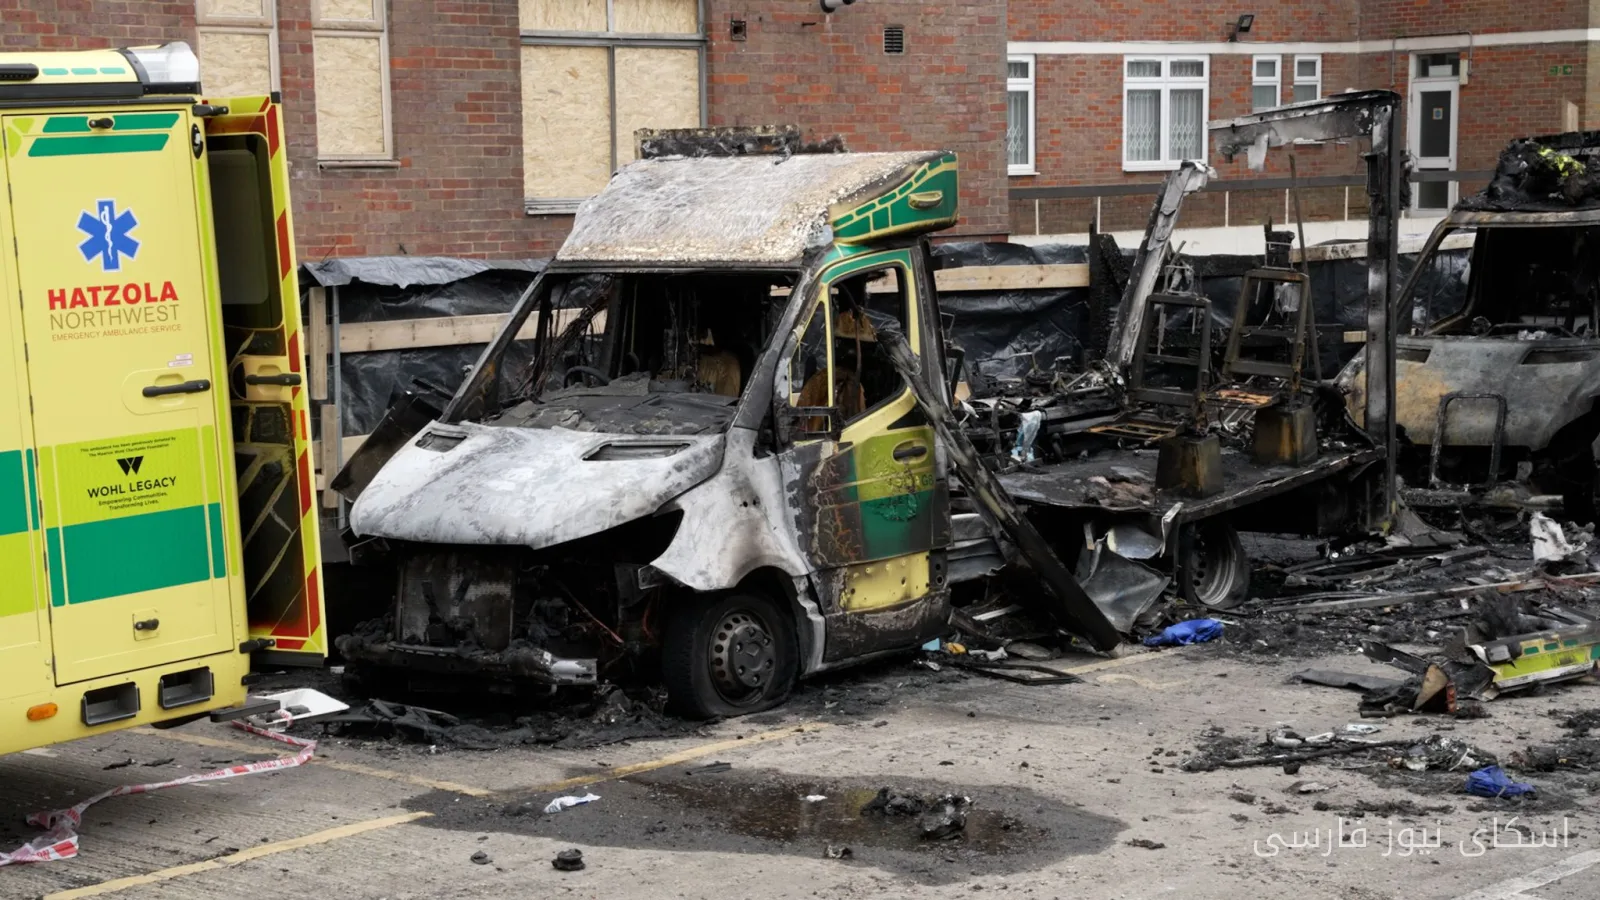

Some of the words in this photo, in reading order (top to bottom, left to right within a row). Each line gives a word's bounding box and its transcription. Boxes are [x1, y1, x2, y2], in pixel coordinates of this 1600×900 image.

[48, 281, 179, 310] HATZOLA
[50, 304, 180, 330] NORTHWEST
[52, 331, 100, 342] EMERGENCY
[103, 327, 148, 337] AMBULANCE
[150, 324, 182, 333] SERVICE
[87, 484, 126, 498] WOHL
[129, 476, 177, 492] LEGACY
[98, 496, 132, 506] Empowering
[109, 500, 143, 511] Transforming
